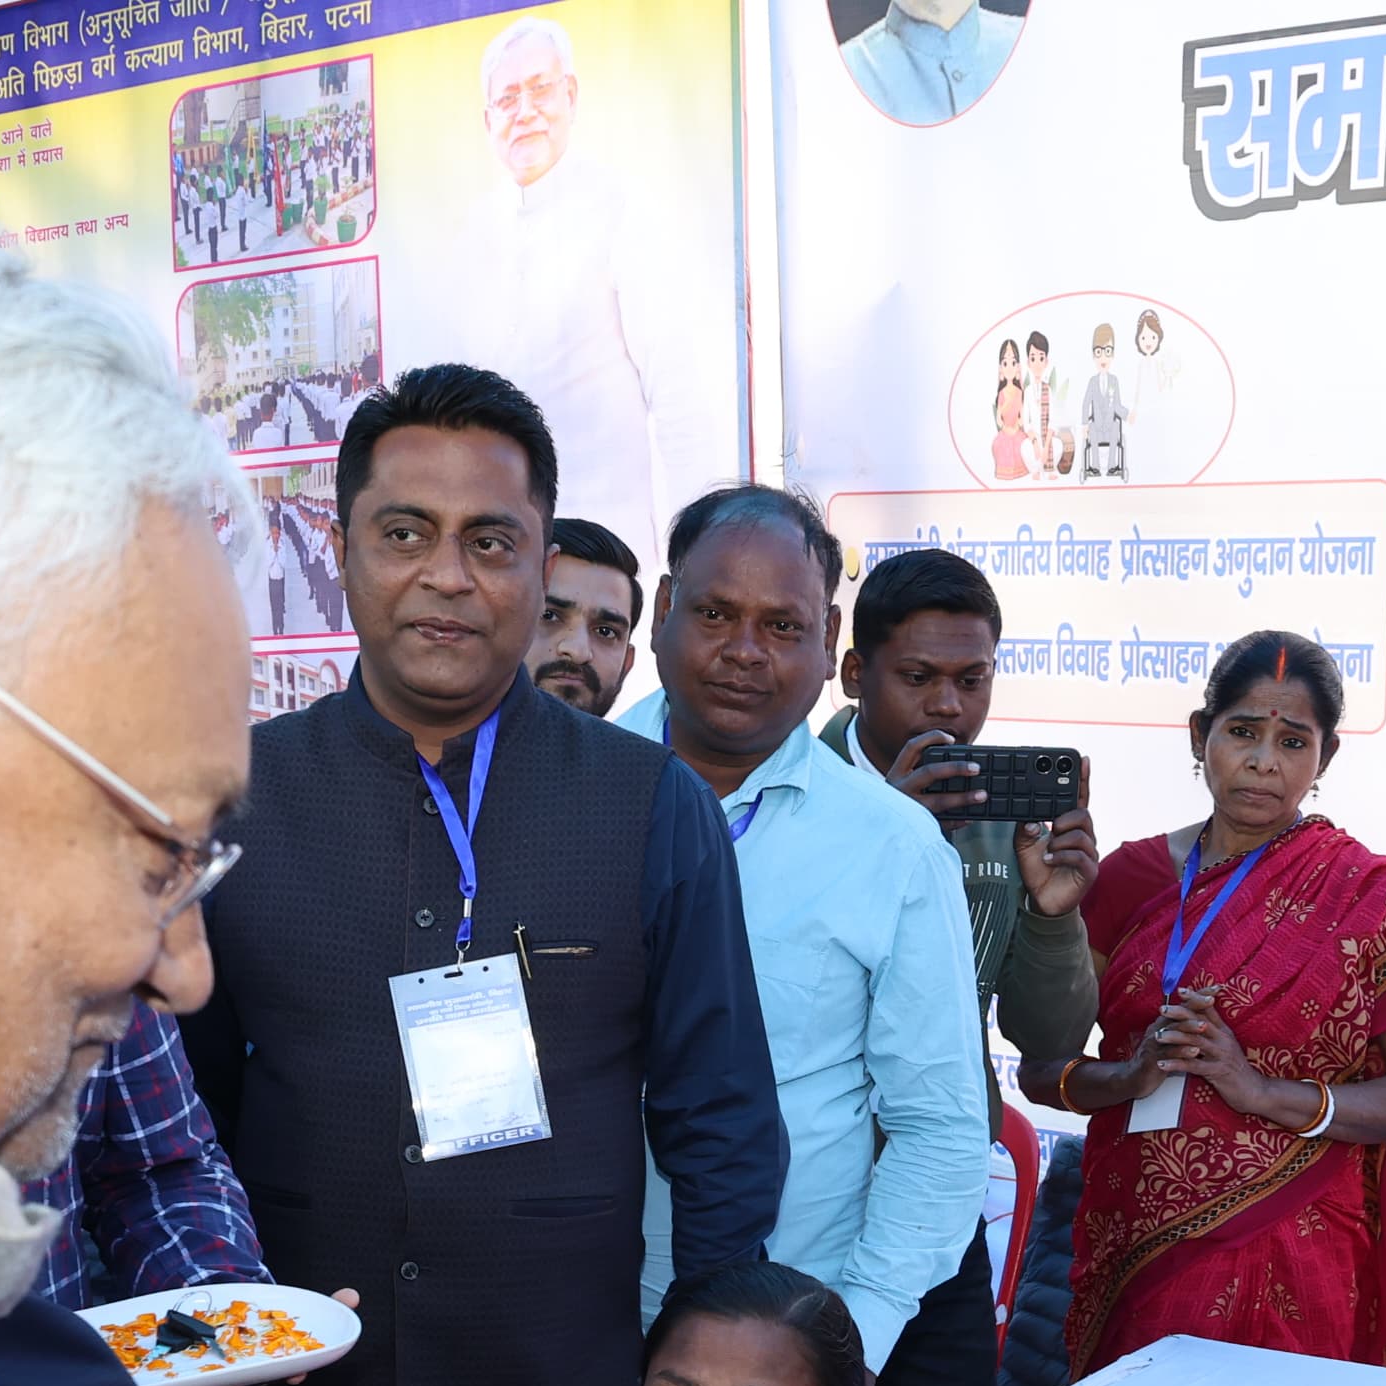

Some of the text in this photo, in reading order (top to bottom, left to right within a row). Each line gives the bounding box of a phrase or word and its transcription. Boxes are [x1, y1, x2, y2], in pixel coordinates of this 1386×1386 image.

[23, 20, 69, 52] विभाग
[34, 57, 83, 93] पिछड़ा
[91, 44, 116, 79] वर्ग
[124, 39, 184, 72] कल्याण
[192, 26, 249, 59] विभाग,
[260, 12, 314, 45] बिहार,
[325, 0, 372, 31] पटना
[1, 124, 23, 145] आने
[30, 118, 53, 139] वाले
[17, 145, 27, 167] में
[33, 146, 63, 166] प्रयास
[26, 223, 69, 245] विद्यालय
[76, 218, 98, 236] तथा
[104, 214, 129, 231] अन्य
[1056, 523, 1112, 582] विवाह
[1120, 524, 1211, 585] प्रोत्साहन
[1213, 536, 1294, 599] अनुदान
[1300, 521, 1376, 577] योजना
[1056, 622, 1112, 681] विवाह
[1120, 625, 1210, 684] प्रोत्साहन
[978, 861, 1009, 879] RIDE
[441, 1125, 536, 1151] FFICER
